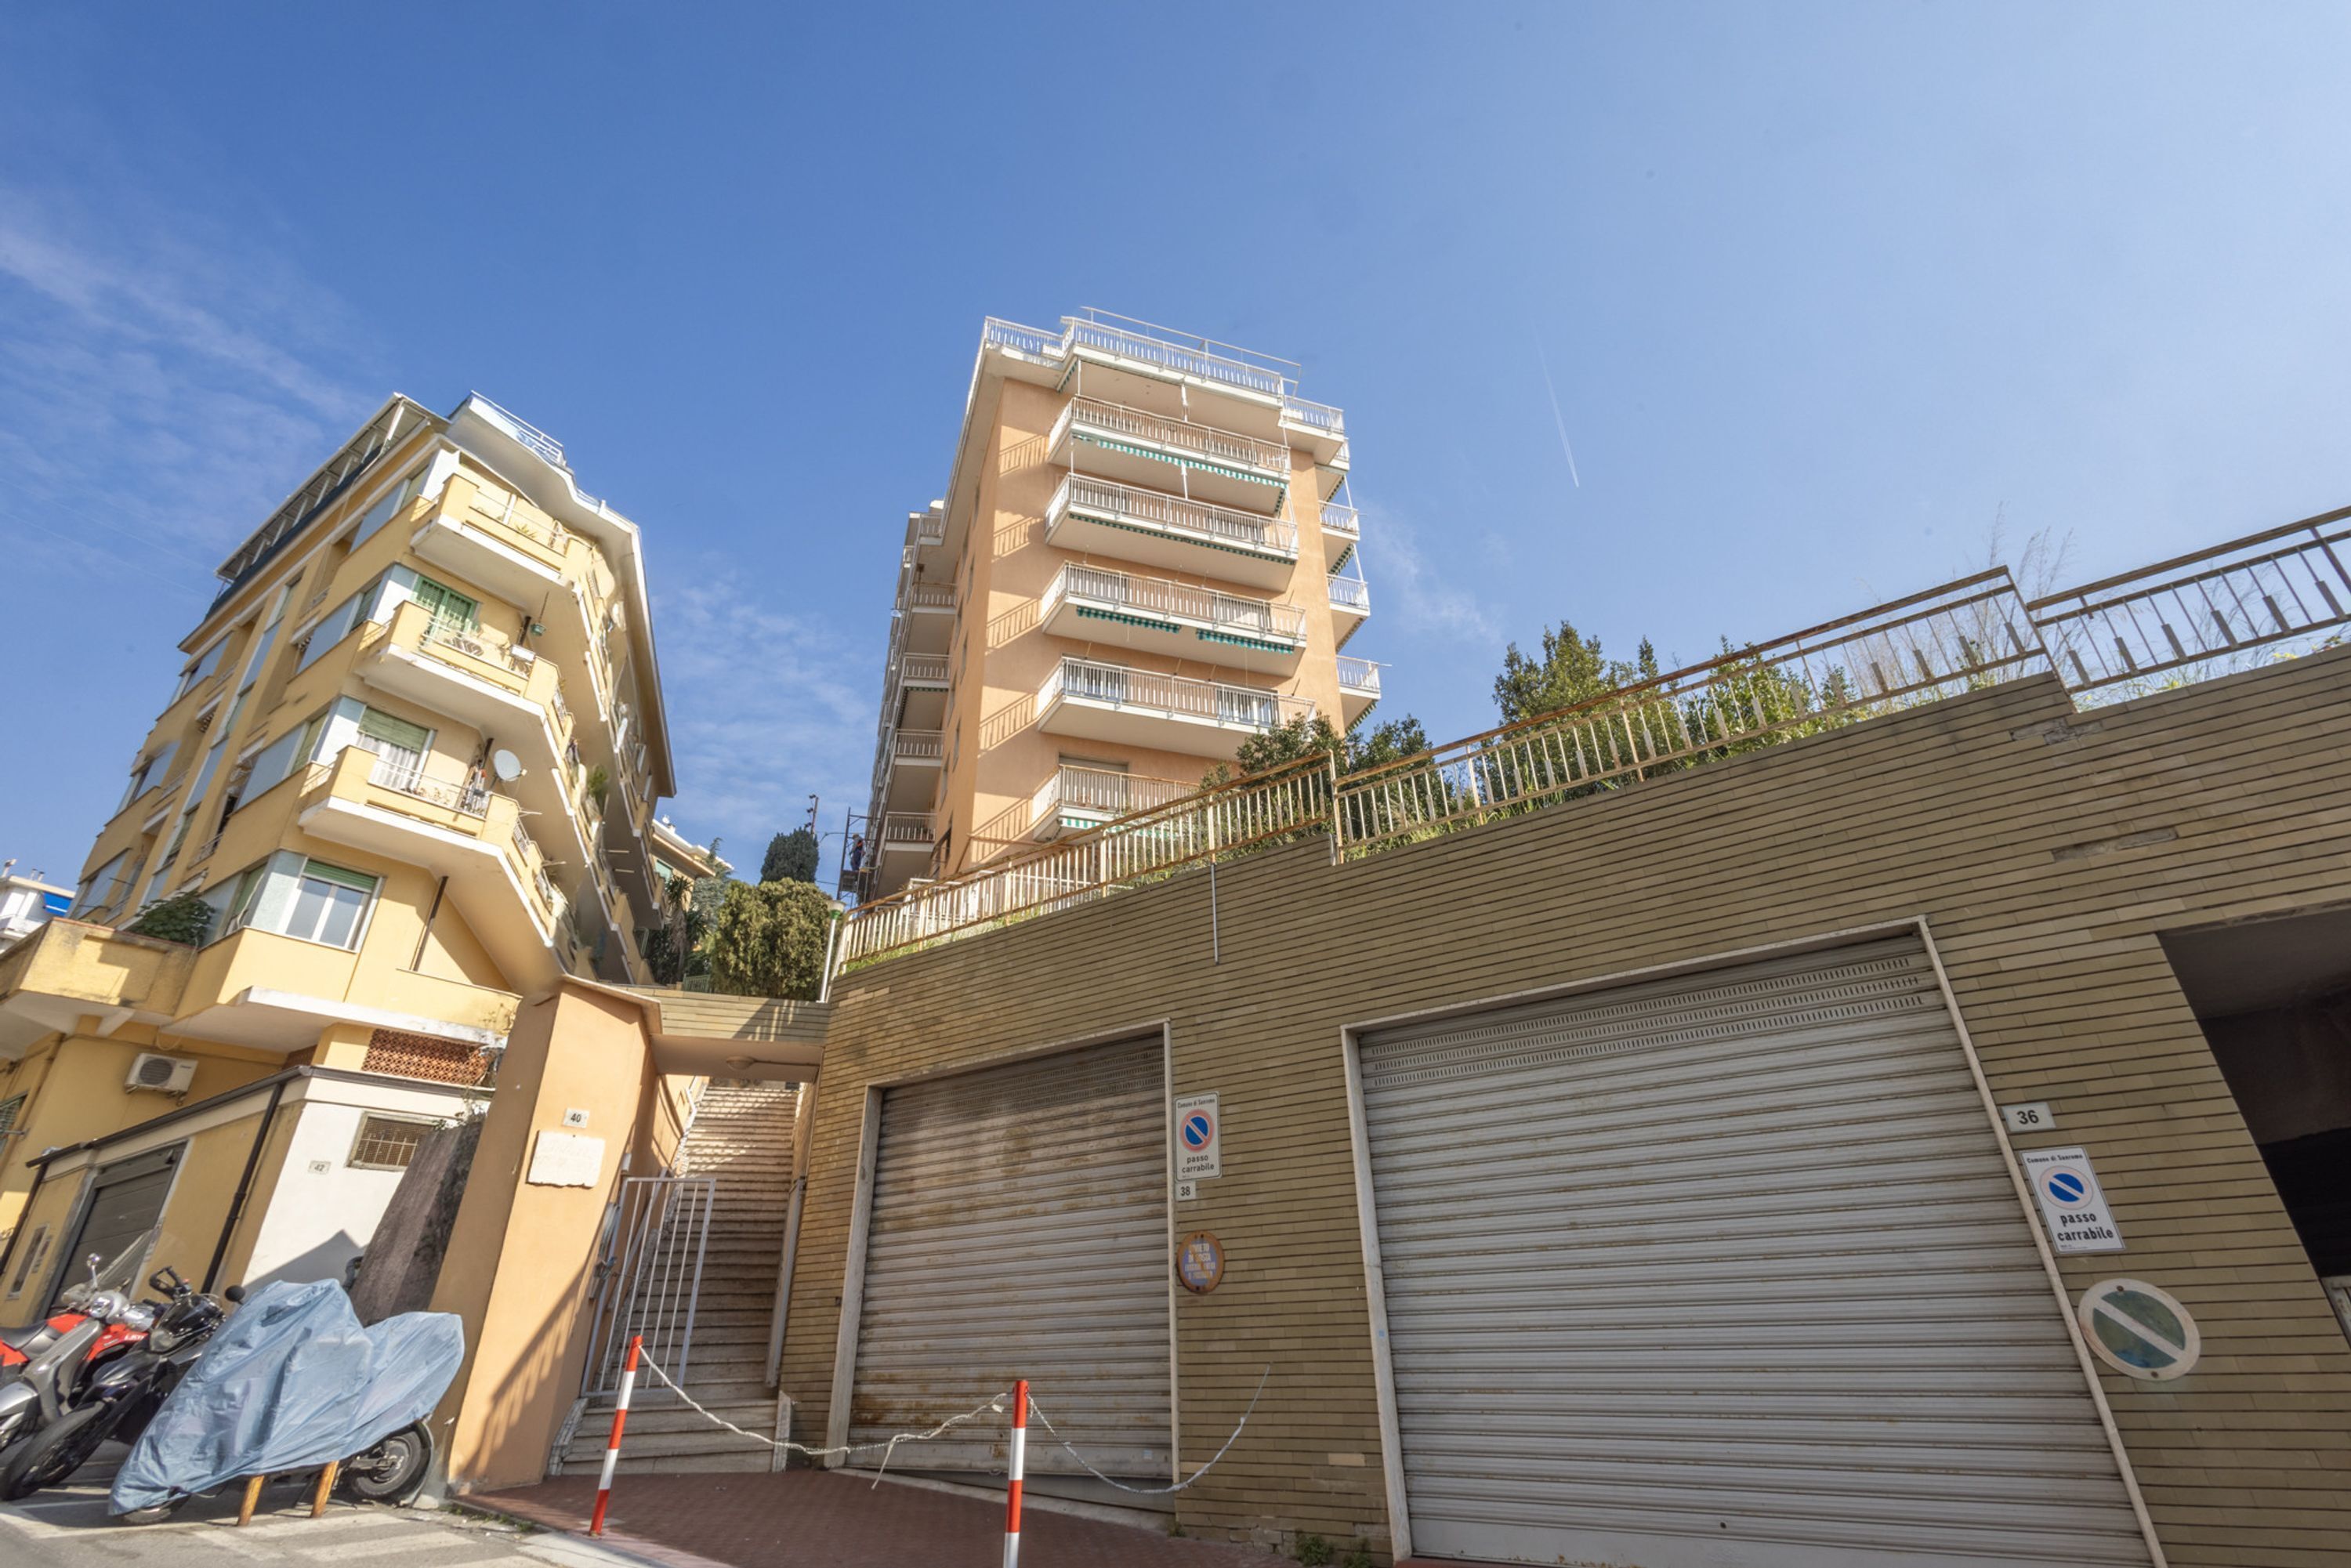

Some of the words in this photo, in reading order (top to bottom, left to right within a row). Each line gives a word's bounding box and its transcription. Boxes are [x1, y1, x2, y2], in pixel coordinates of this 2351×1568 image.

[571, 1113, 582, 1123] 40
[2016, 1110, 2039, 1125] 36
[1186, 1155, 1208, 1164] passo
[1182, 1163, 1215, 1173] carrabile
[1180, 1186, 1190, 1197] 38
[2059, 1213, 2096, 1227] passo
[2057, 1226, 2114, 1242] carrabile
